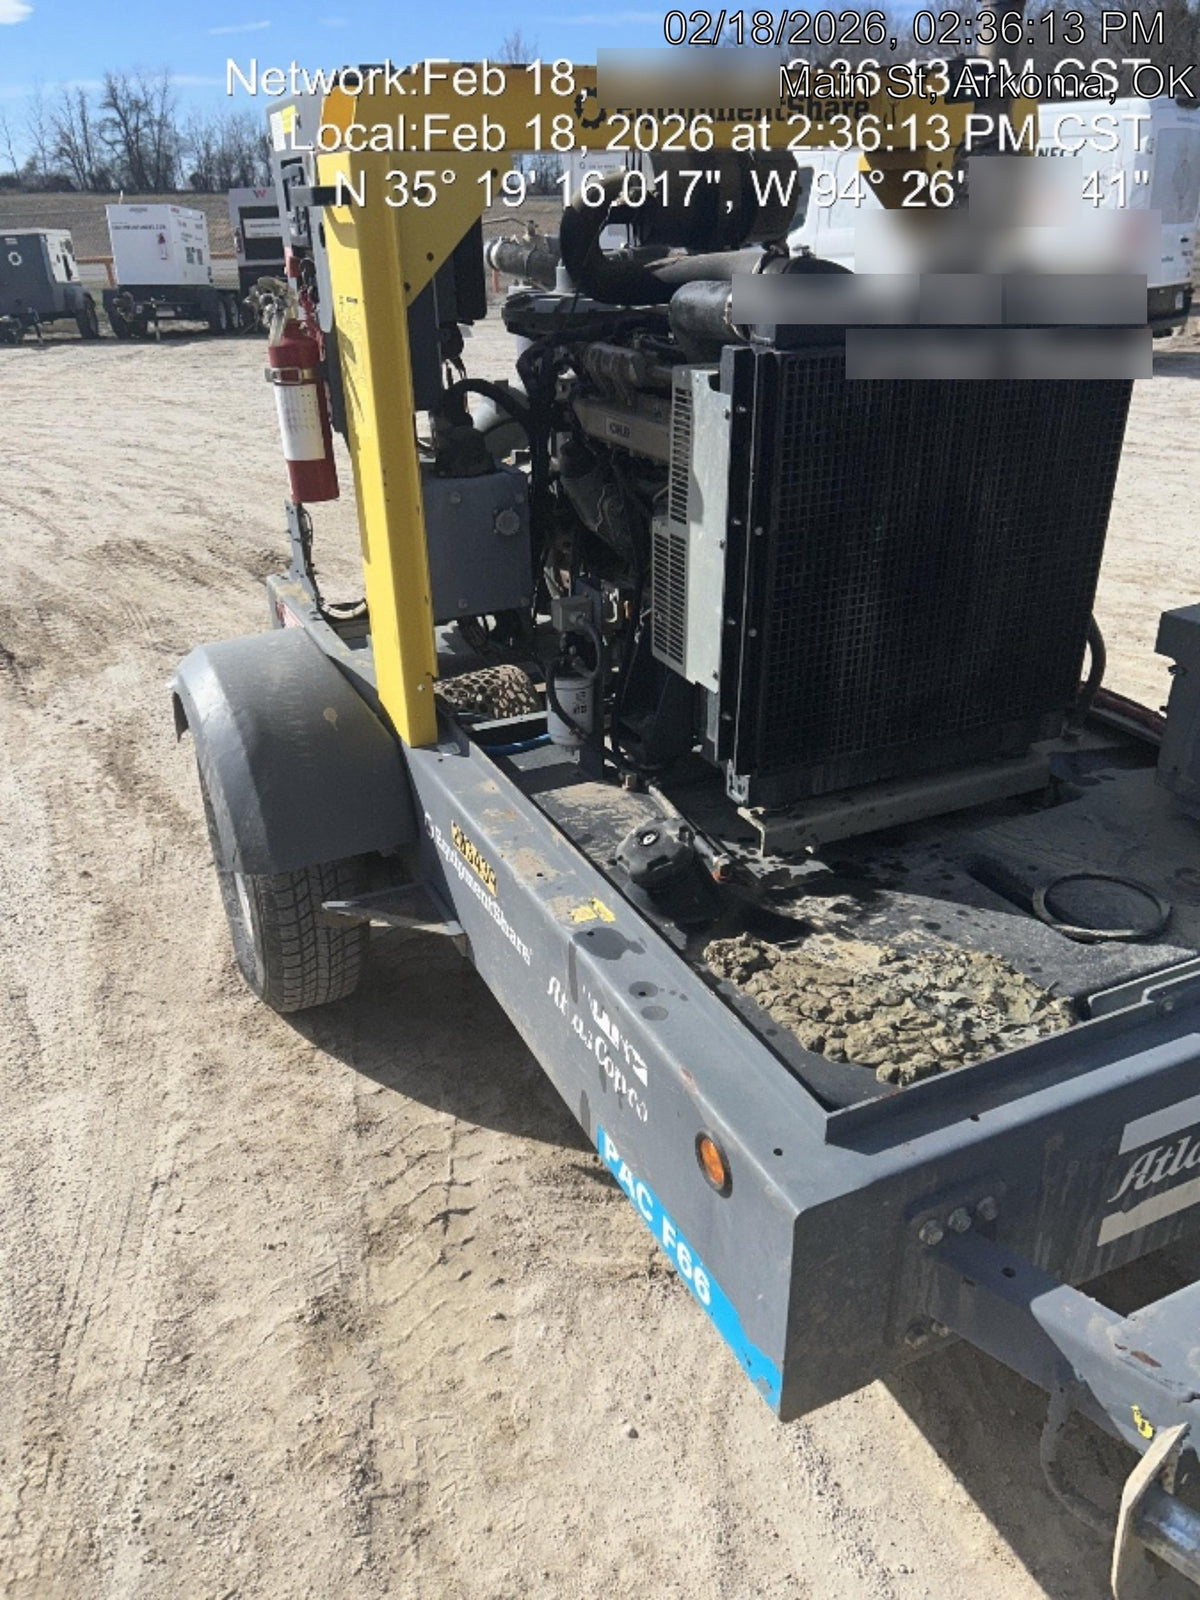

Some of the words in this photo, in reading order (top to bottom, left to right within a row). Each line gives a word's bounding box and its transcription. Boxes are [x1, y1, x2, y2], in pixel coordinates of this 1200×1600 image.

[547, 975, 593, 1050] Atas
[604, 1132, 653, 1222] PAC
[662, 1215, 711, 1306] F66
